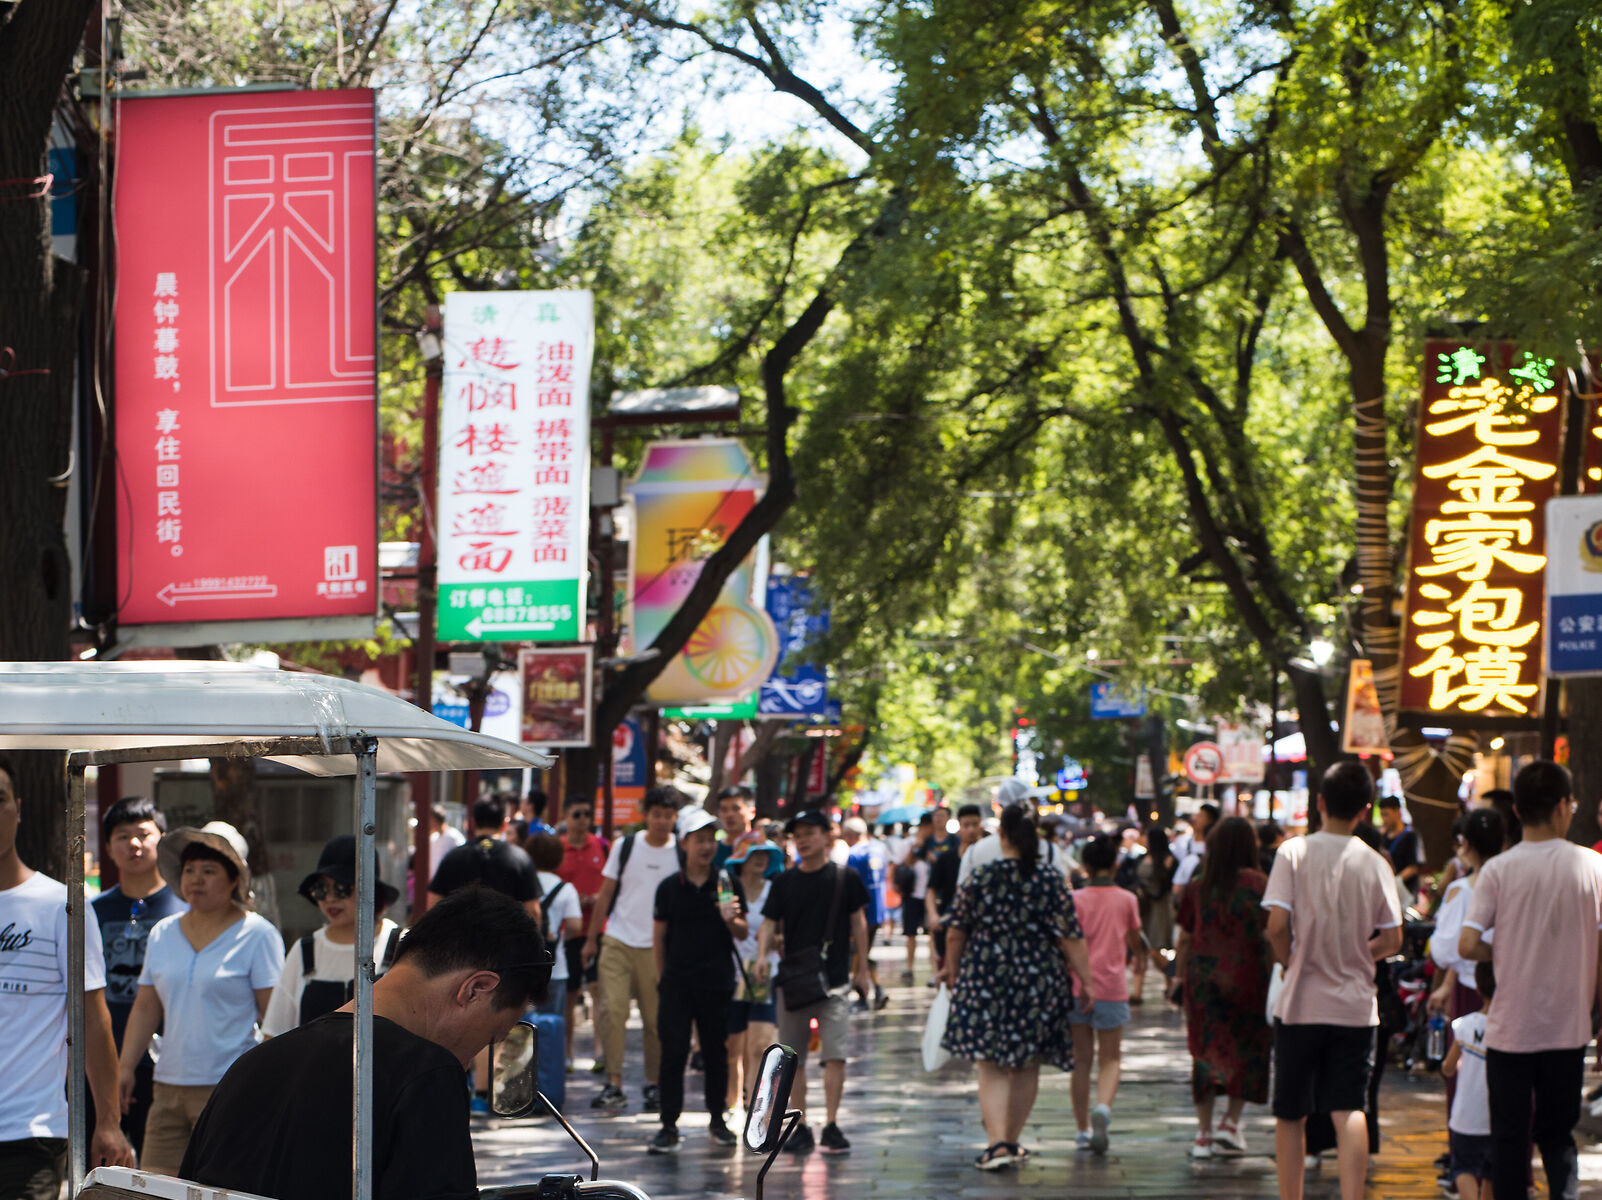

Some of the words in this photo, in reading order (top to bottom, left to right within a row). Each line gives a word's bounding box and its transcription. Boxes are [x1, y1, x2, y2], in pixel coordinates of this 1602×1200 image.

[1408, 377, 1559, 714] 老金家泡馍
[1558, 614, 1602, 634] 公安
[1558, 639, 1597, 651] POLICE
[0, 981, 28, 993] RIES
